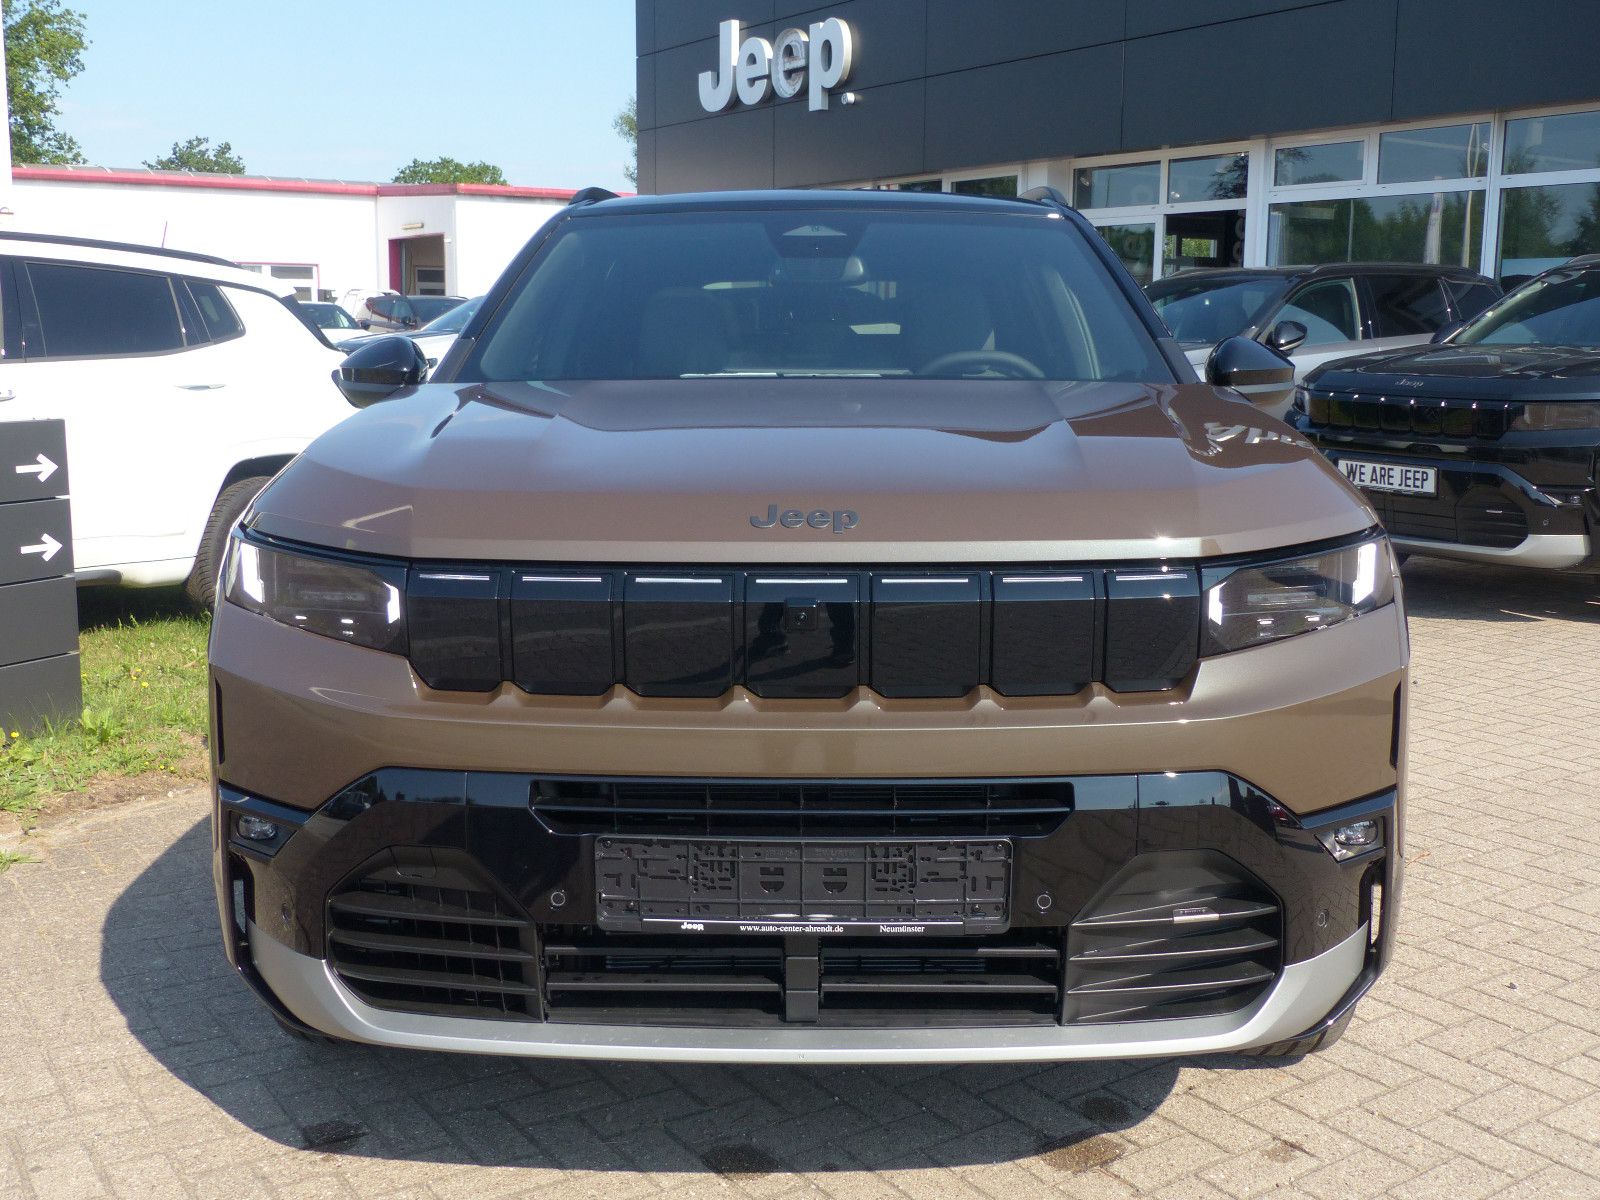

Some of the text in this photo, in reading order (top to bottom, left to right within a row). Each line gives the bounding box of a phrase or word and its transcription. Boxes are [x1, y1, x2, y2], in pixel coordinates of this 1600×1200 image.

[1345, 462, 1429, 489] WE ARE JEEP
[749, 503, 860, 534] Jeep
[739, 924, 844, 933] www.auto-center-ahrendt.de
[879, 925, 925, 933] Neumünster
